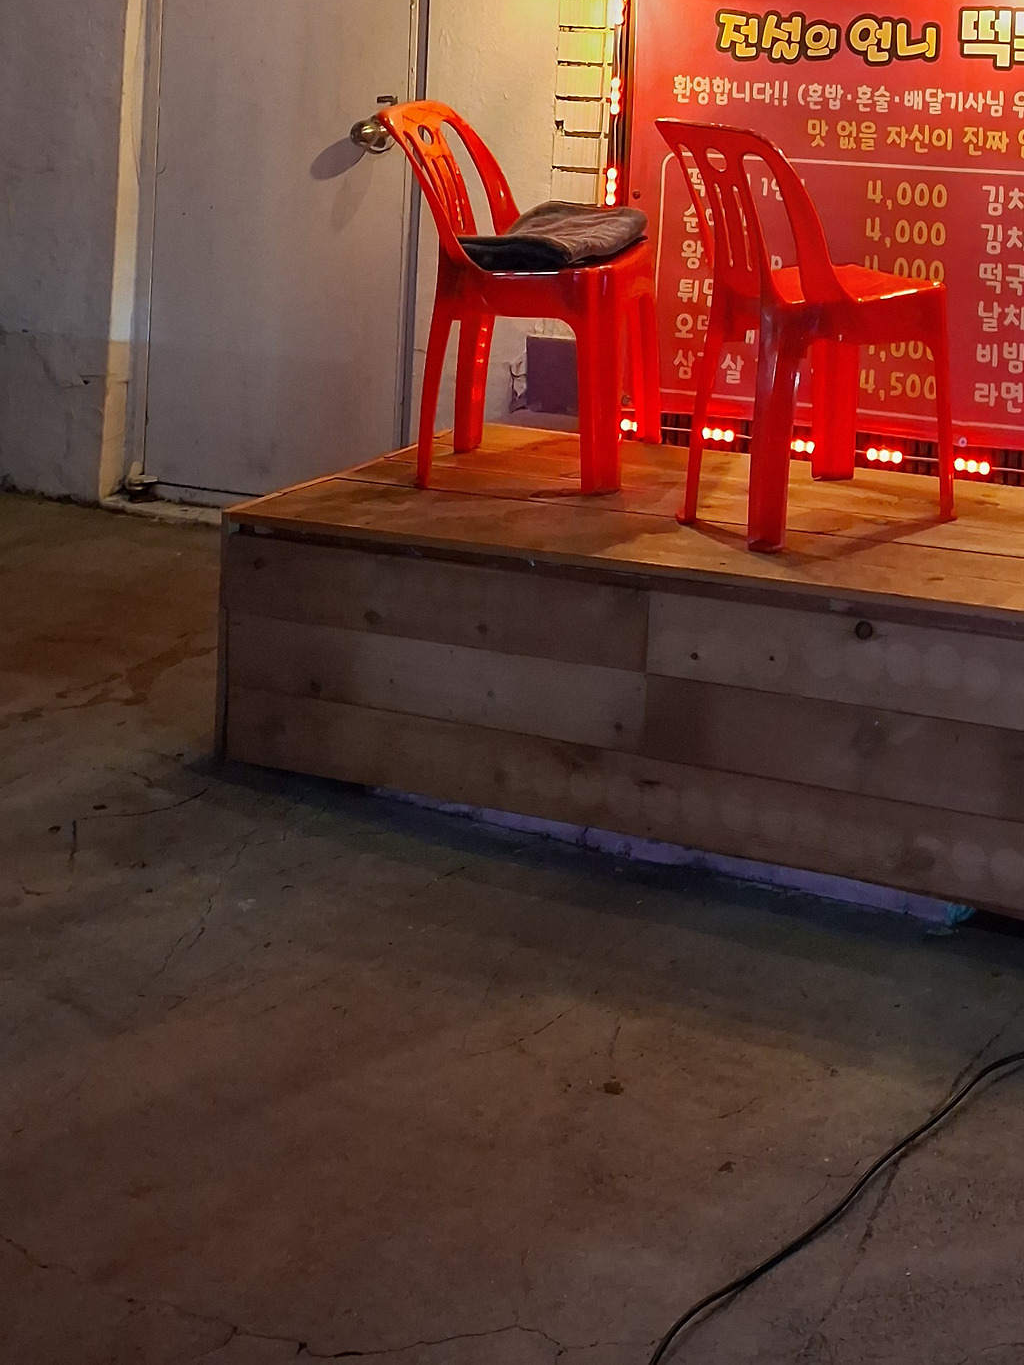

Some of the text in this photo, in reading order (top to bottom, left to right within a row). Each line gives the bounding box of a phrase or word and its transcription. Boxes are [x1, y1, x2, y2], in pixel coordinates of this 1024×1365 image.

[717, 10, 838, 60] 전설의
[849, 16, 938, 62] 언니
[673, 75, 788, 107] 환영합니다!!
[807, 119, 829, 148] 맛
[836, 120, 878, 151] 없을
[886, 124, 954, 154] 자신이
[962, 125, 1010, 156] 진짜
[866, 179, 948, 211] 4,000
[865, 216, 947, 249] 4,000
[673, 349, 744, 384] 삼살
[860, 368, 938, 402] 4,500
